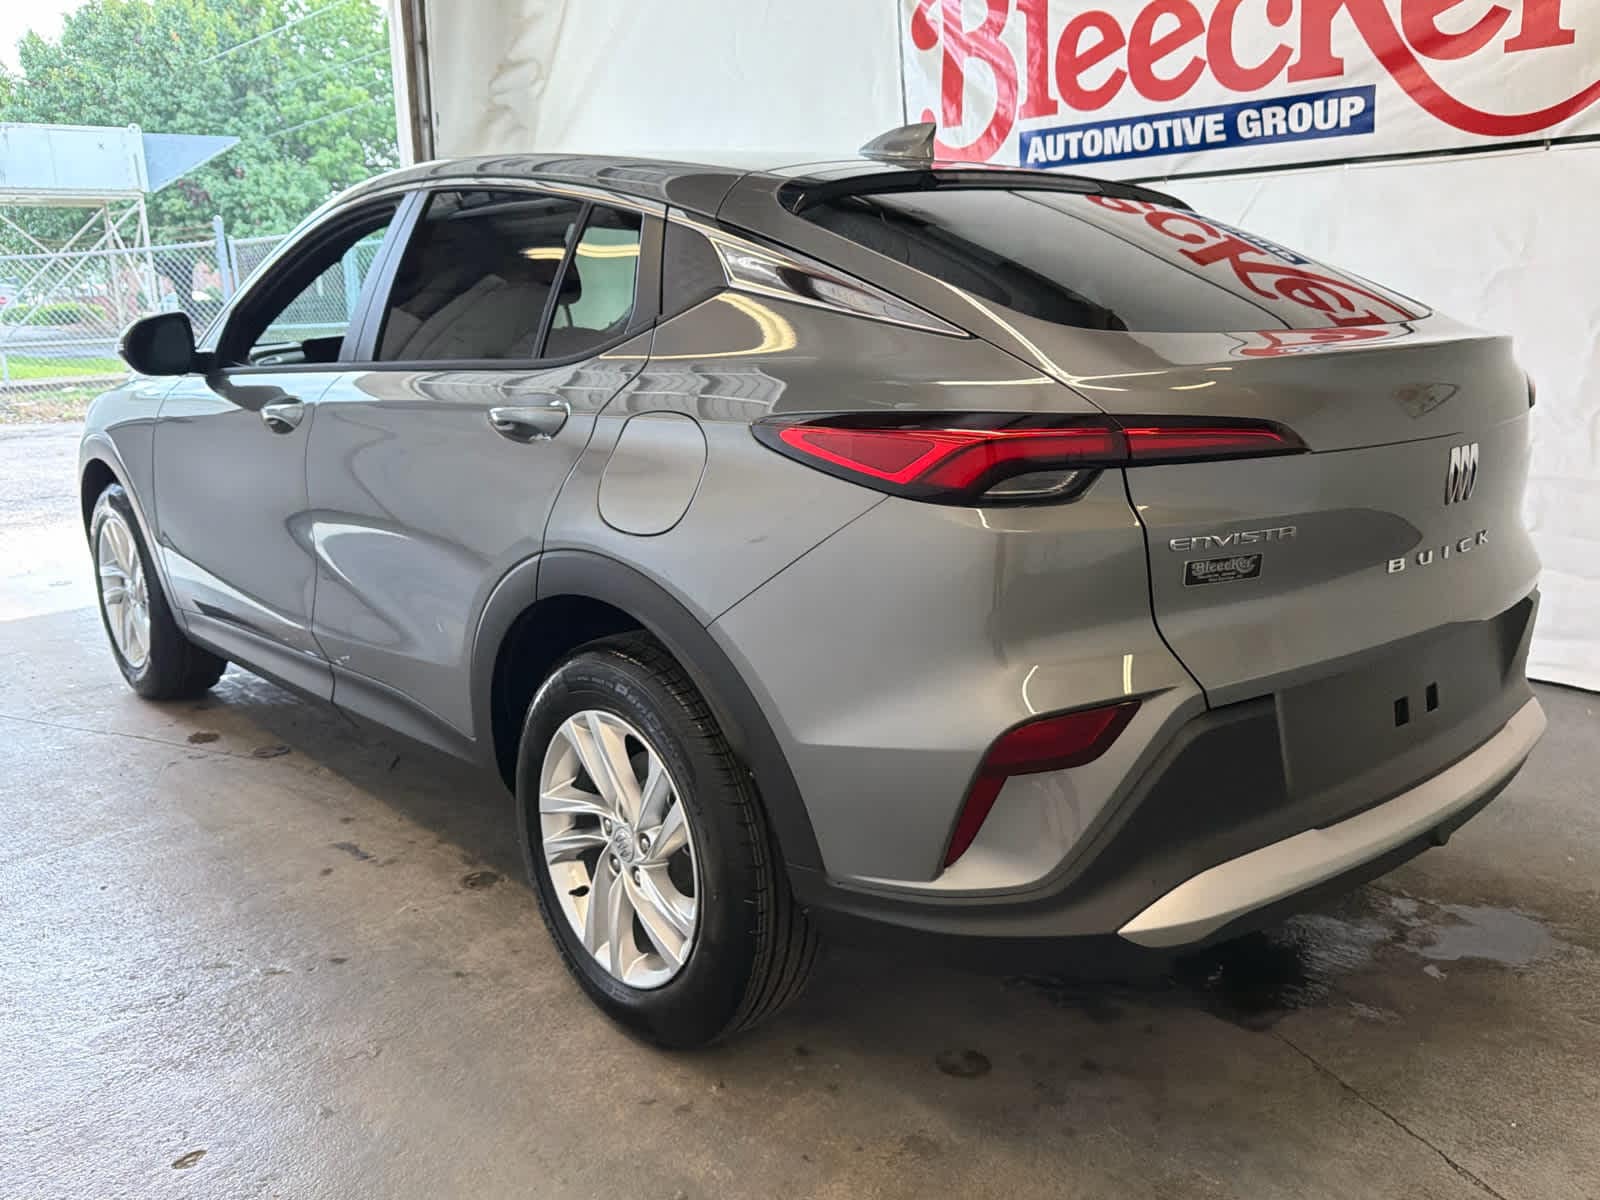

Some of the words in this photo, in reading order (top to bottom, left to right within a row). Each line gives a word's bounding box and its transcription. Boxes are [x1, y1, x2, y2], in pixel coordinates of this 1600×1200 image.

[1027, 112, 1227, 164] AUTOMOTIVE
[1237, 95, 1366, 139] GROUP
[1169, 526, 1297, 552] ENVISTA
[1386, 529, 1489, 574] BUICK
